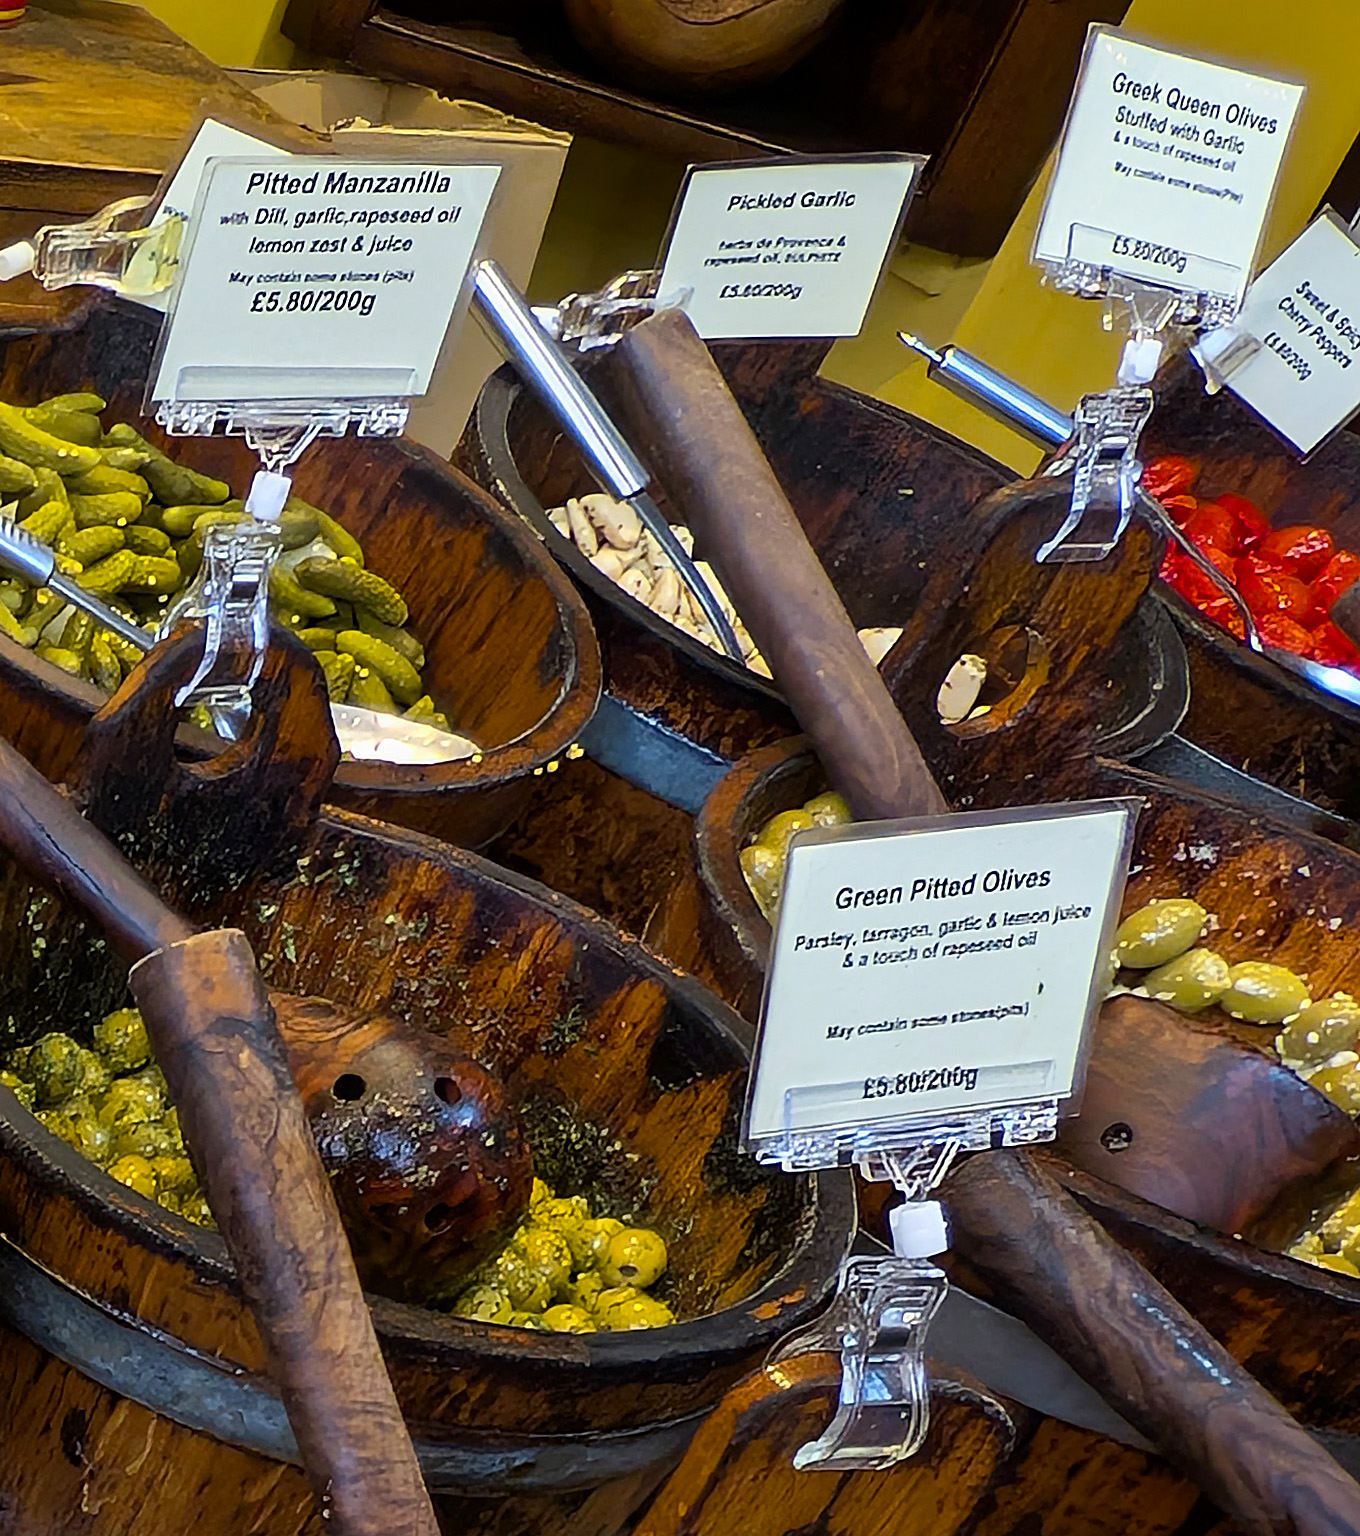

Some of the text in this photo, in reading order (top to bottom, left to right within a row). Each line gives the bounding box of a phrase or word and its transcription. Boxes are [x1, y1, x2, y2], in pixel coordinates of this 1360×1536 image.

[1112, 72, 1278, 135] Greek Queen Olives
[1115, 105, 1169, 134] Stuffed
[245, 170, 451, 195] Pitted Manzanilla
[800, 190, 856, 208] Garlic
[254, 207, 289, 227] Dill,
[437, 206, 462, 223] oil
[248, 234, 413, 257] lemon zest & juice
[249, 290, 377, 317] £5.80/200g
